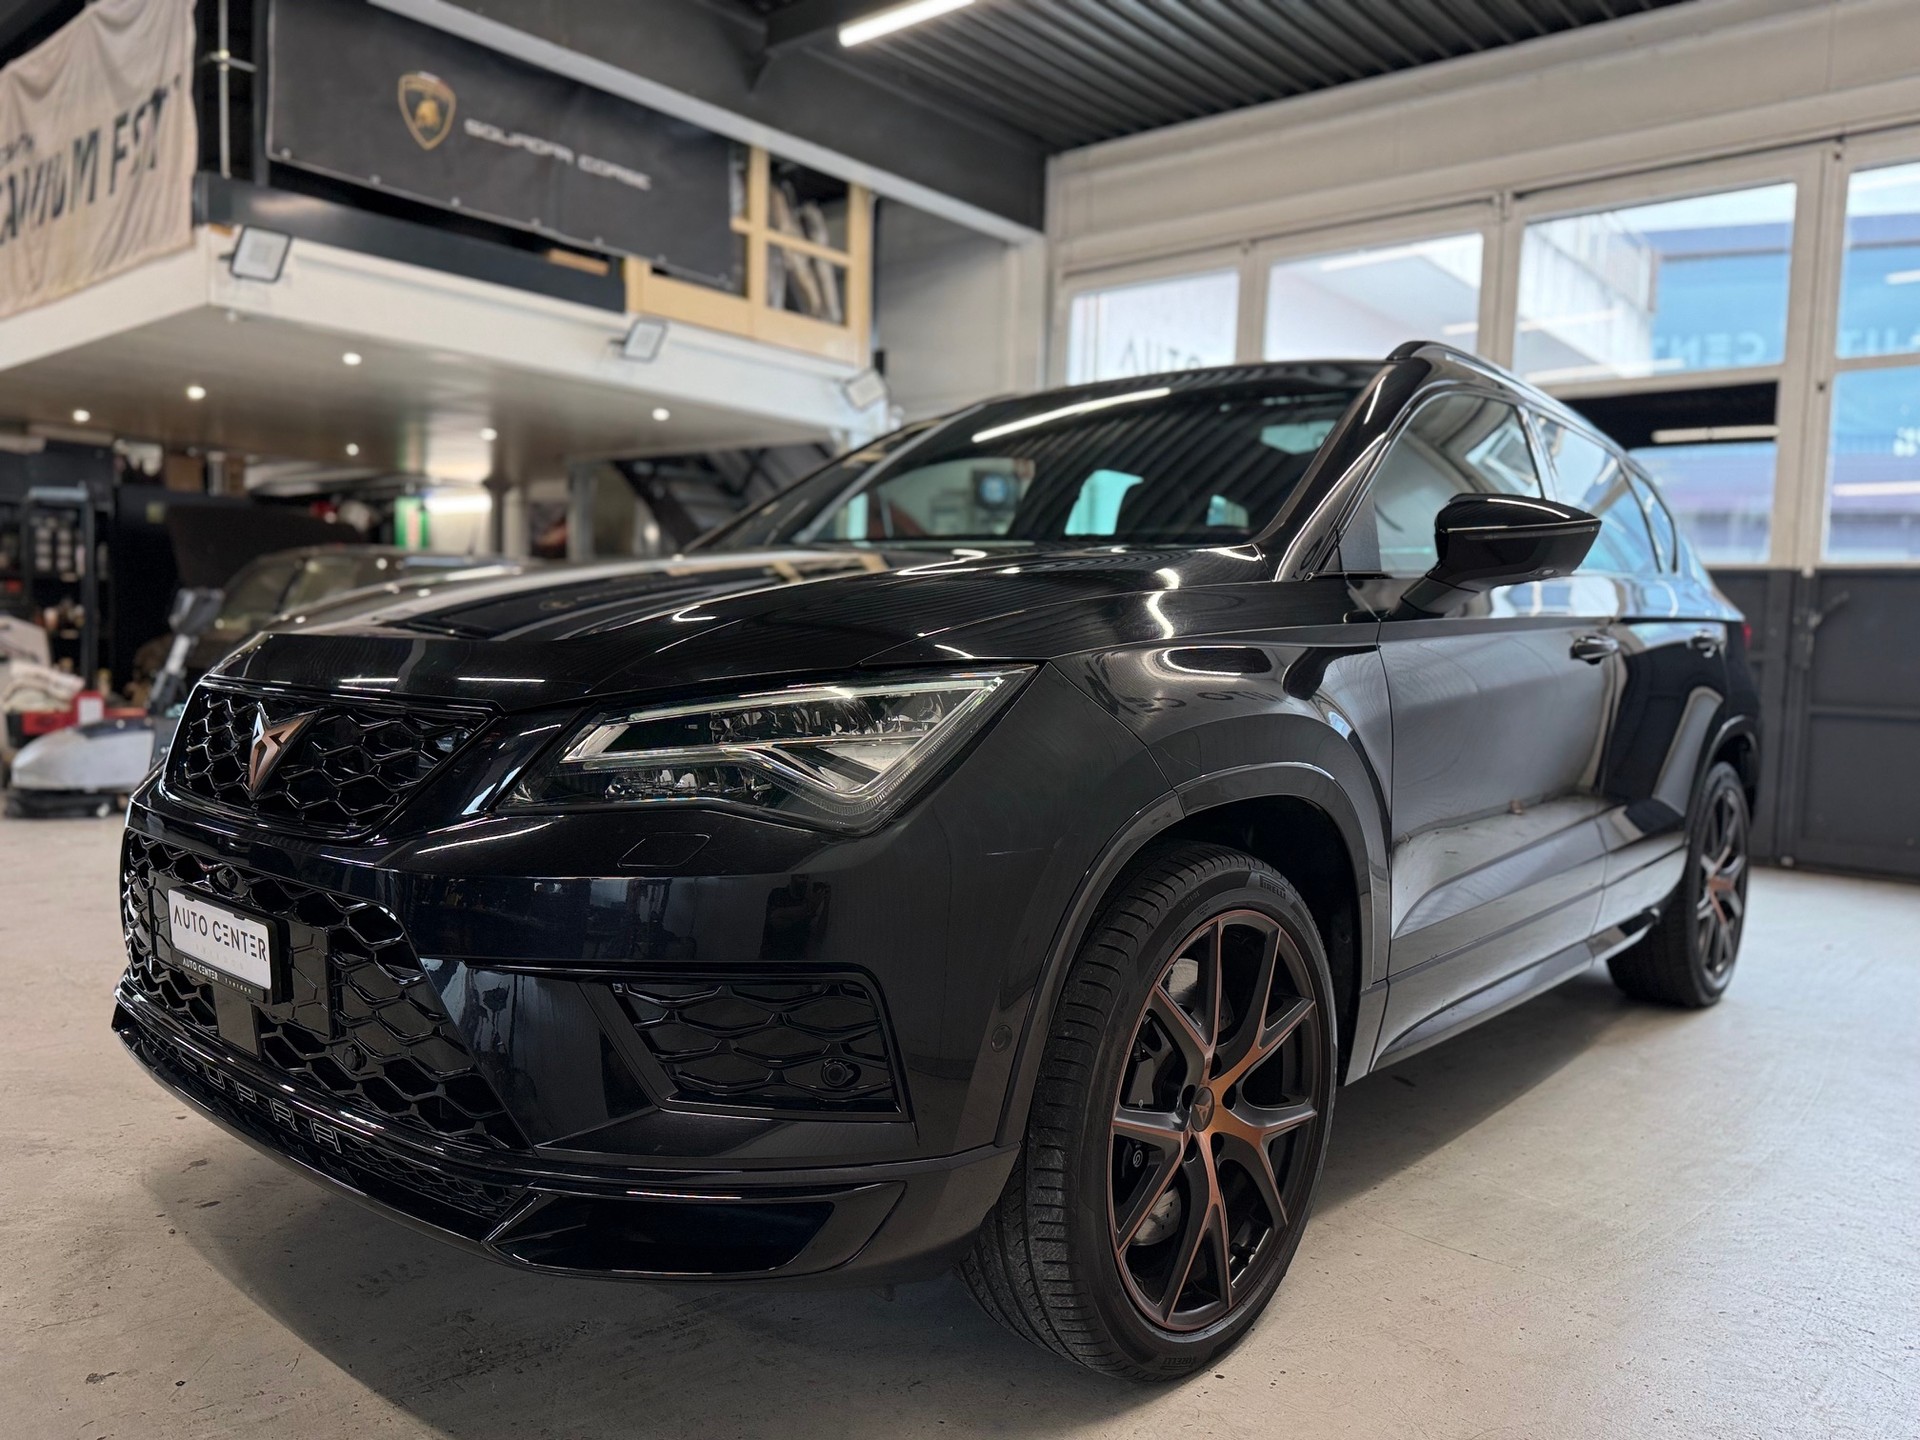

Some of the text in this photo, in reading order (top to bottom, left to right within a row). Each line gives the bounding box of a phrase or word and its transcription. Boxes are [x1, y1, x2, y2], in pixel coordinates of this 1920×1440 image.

[1259, 875, 1287, 899] PIRELLI
[174, 905, 208, 936] AUTO
[212, 921, 267, 961] CENTER
[182, 957, 197, 971] AUTO
[198, 964, 219, 982] CENTER
